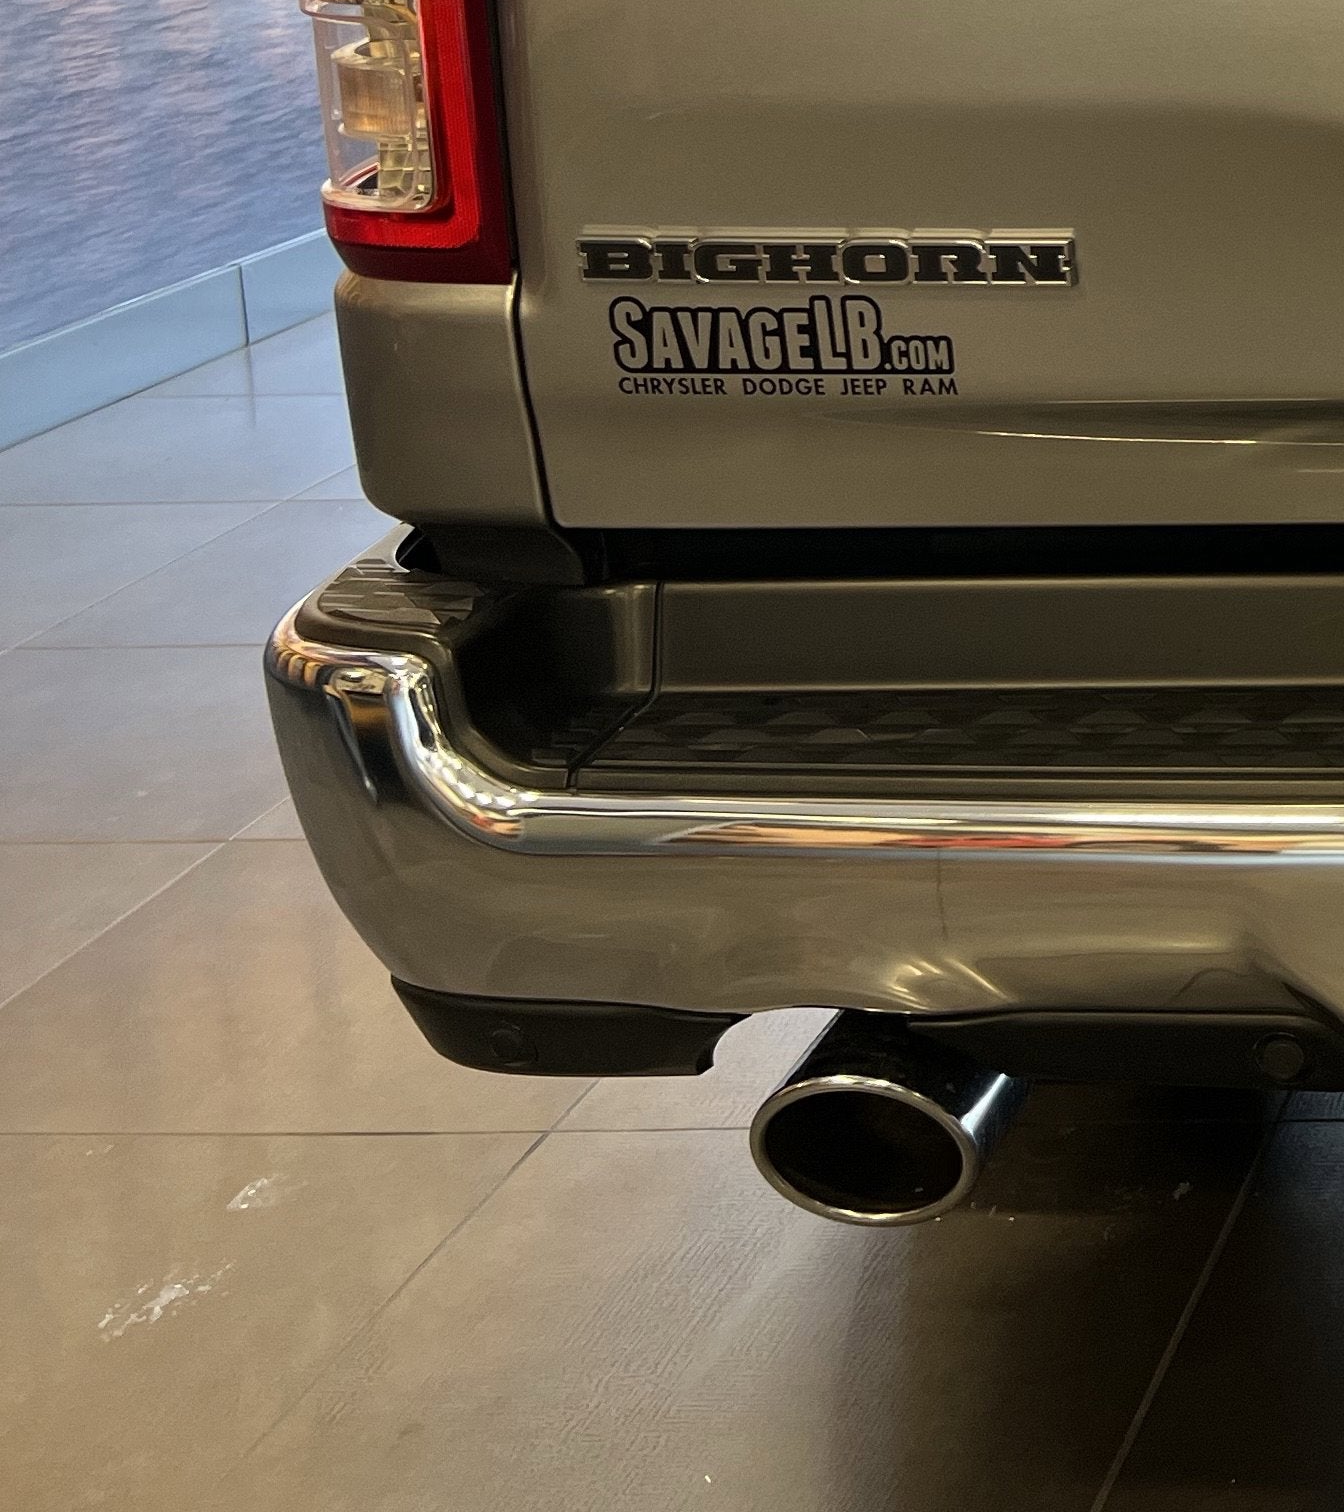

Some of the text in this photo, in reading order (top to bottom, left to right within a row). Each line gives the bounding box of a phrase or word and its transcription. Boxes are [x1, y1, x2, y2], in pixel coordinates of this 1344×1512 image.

[577, 234, 1076, 287] BIGHORN
[618, 377, 959, 396] CHRYSLER DODGE JEEP RAM
